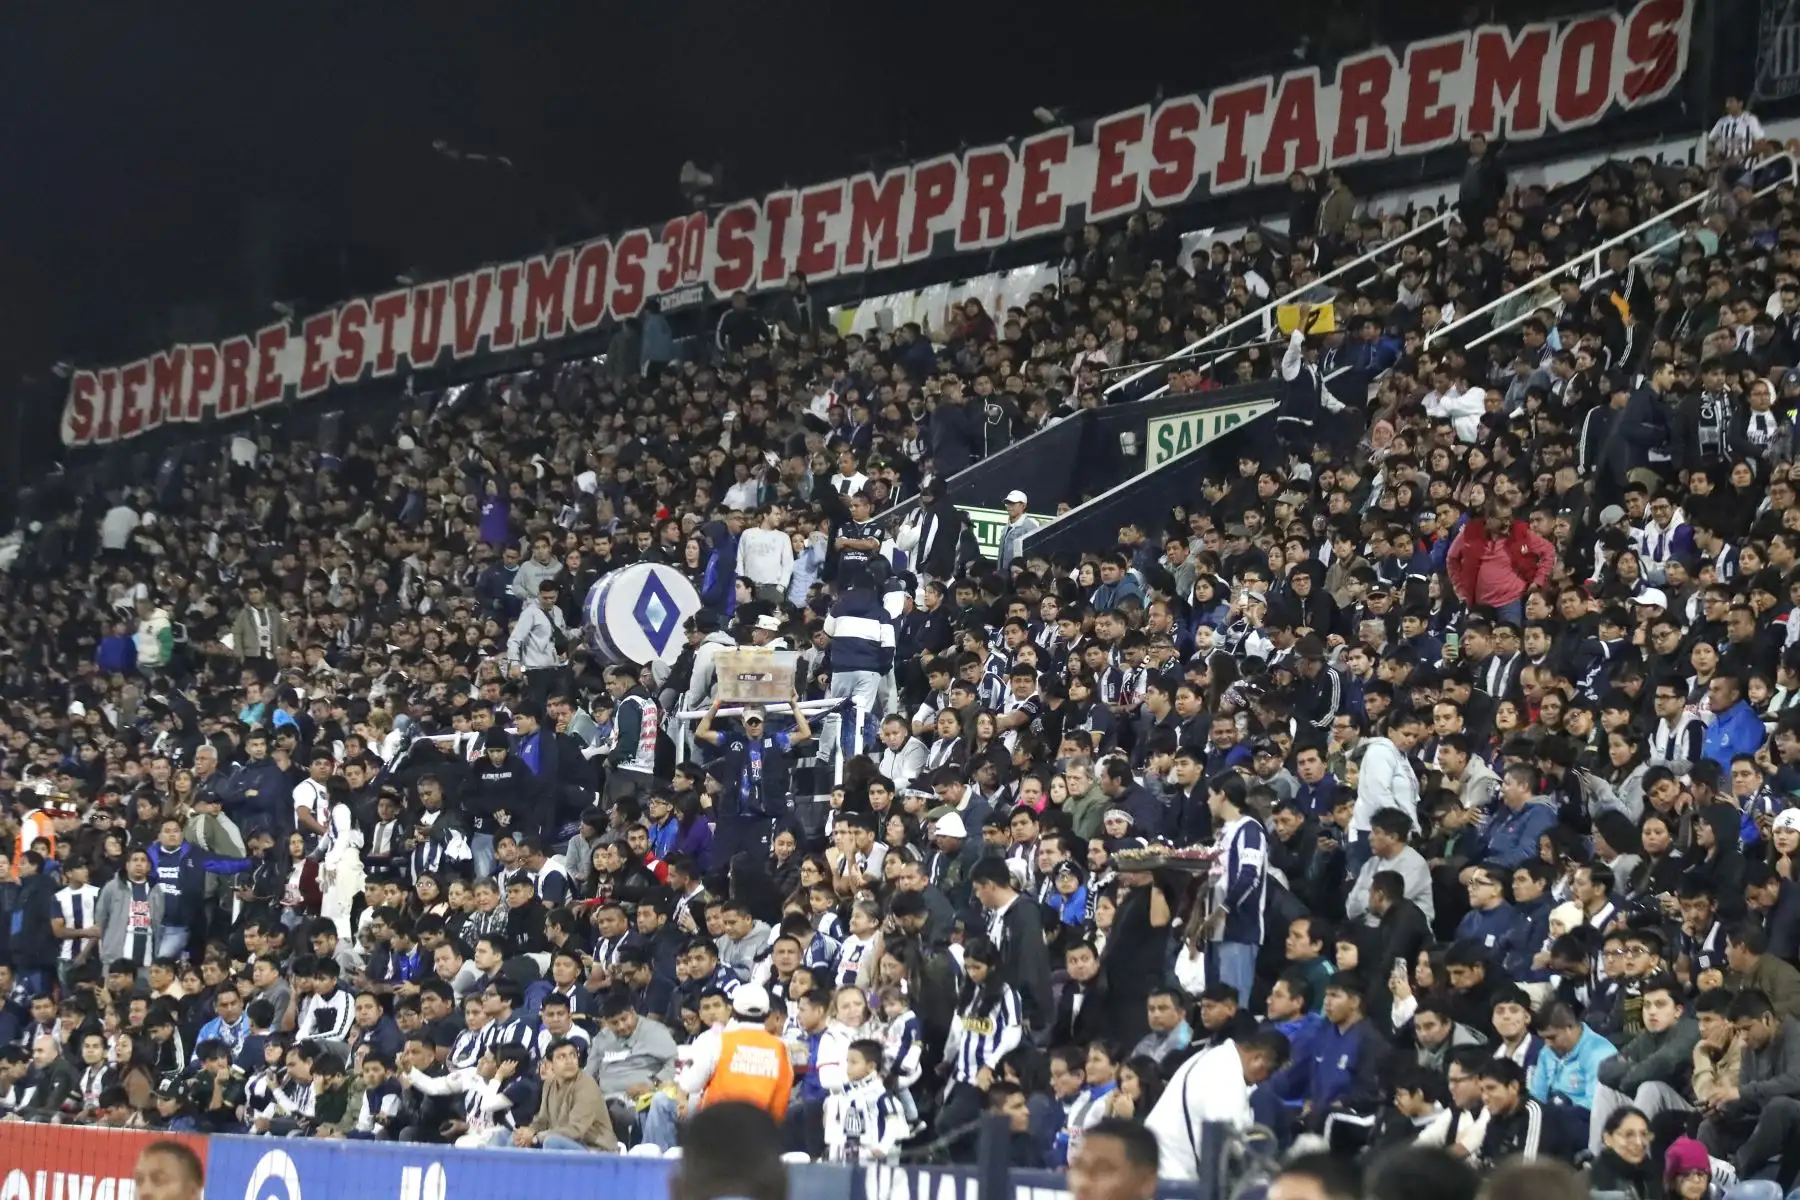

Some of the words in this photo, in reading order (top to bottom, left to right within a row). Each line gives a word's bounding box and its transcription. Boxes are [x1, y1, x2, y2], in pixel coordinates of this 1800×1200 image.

[70, 323, 289, 442] SIEMPRE
[300, 232, 650, 390] ESTUVIMOS
[657, 212, 708, 292] 30
[712, 132, 1071, 295] SIEMPRE
[1091, 0, 1689, 215] ESTAREMOS
[1156, 409, 1257, 465] SALI
